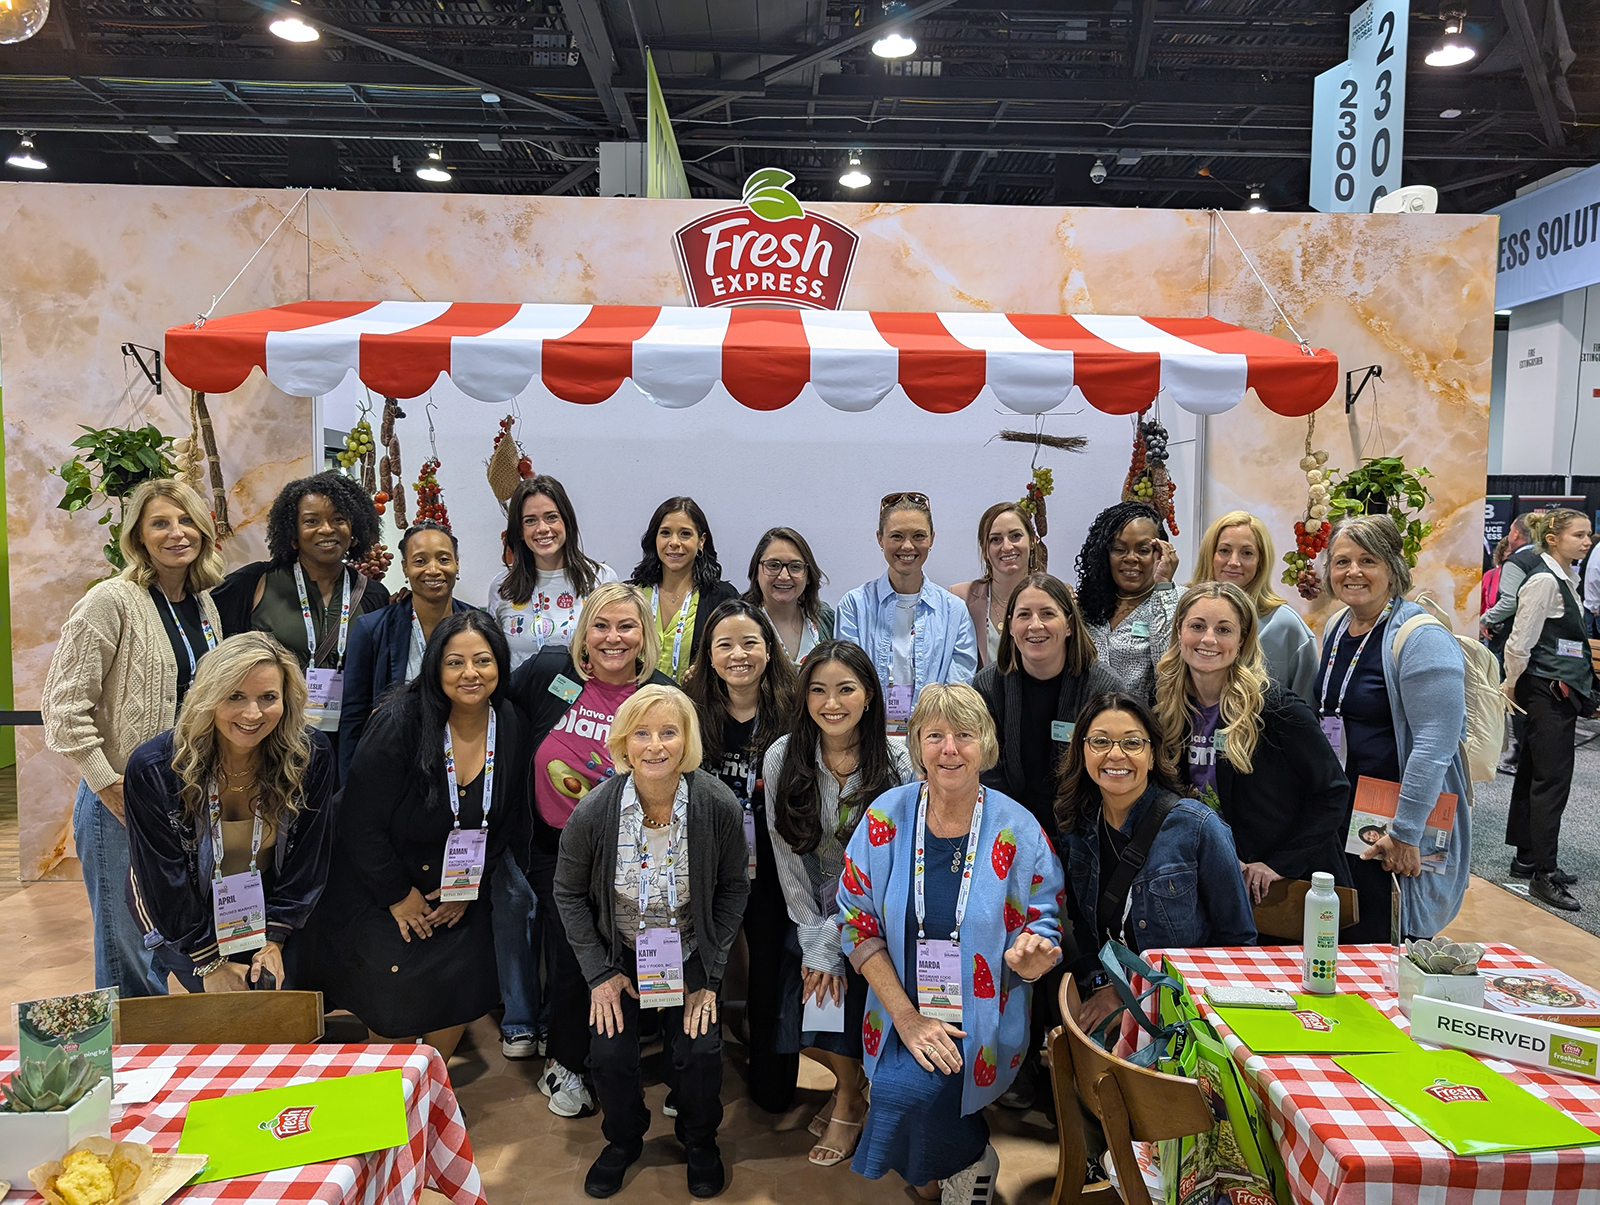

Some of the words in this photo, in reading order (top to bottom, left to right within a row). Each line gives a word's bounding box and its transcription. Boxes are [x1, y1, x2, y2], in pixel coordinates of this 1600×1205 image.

[1334, 79, 1358, 201] 2300
[701, 218, 833, 277] Fresh
[711, 272, 825, 298] EXPRESS
[579, 705, 605, 720] have
[218, 895, 236, 906] APRIL
[638, 949, 657, 957] KATHY
[918, 960, 940, 969] MARDA
[1437, 1015, 1547, 1052] RESERVED
[1176, 1035, 1184, 1051] VIP
[1553, 1052, 1589, 1066] freshness
[1430, 1086, 1480, 1098] Fresh
[276, 1109, 303, 1136] Fresh
